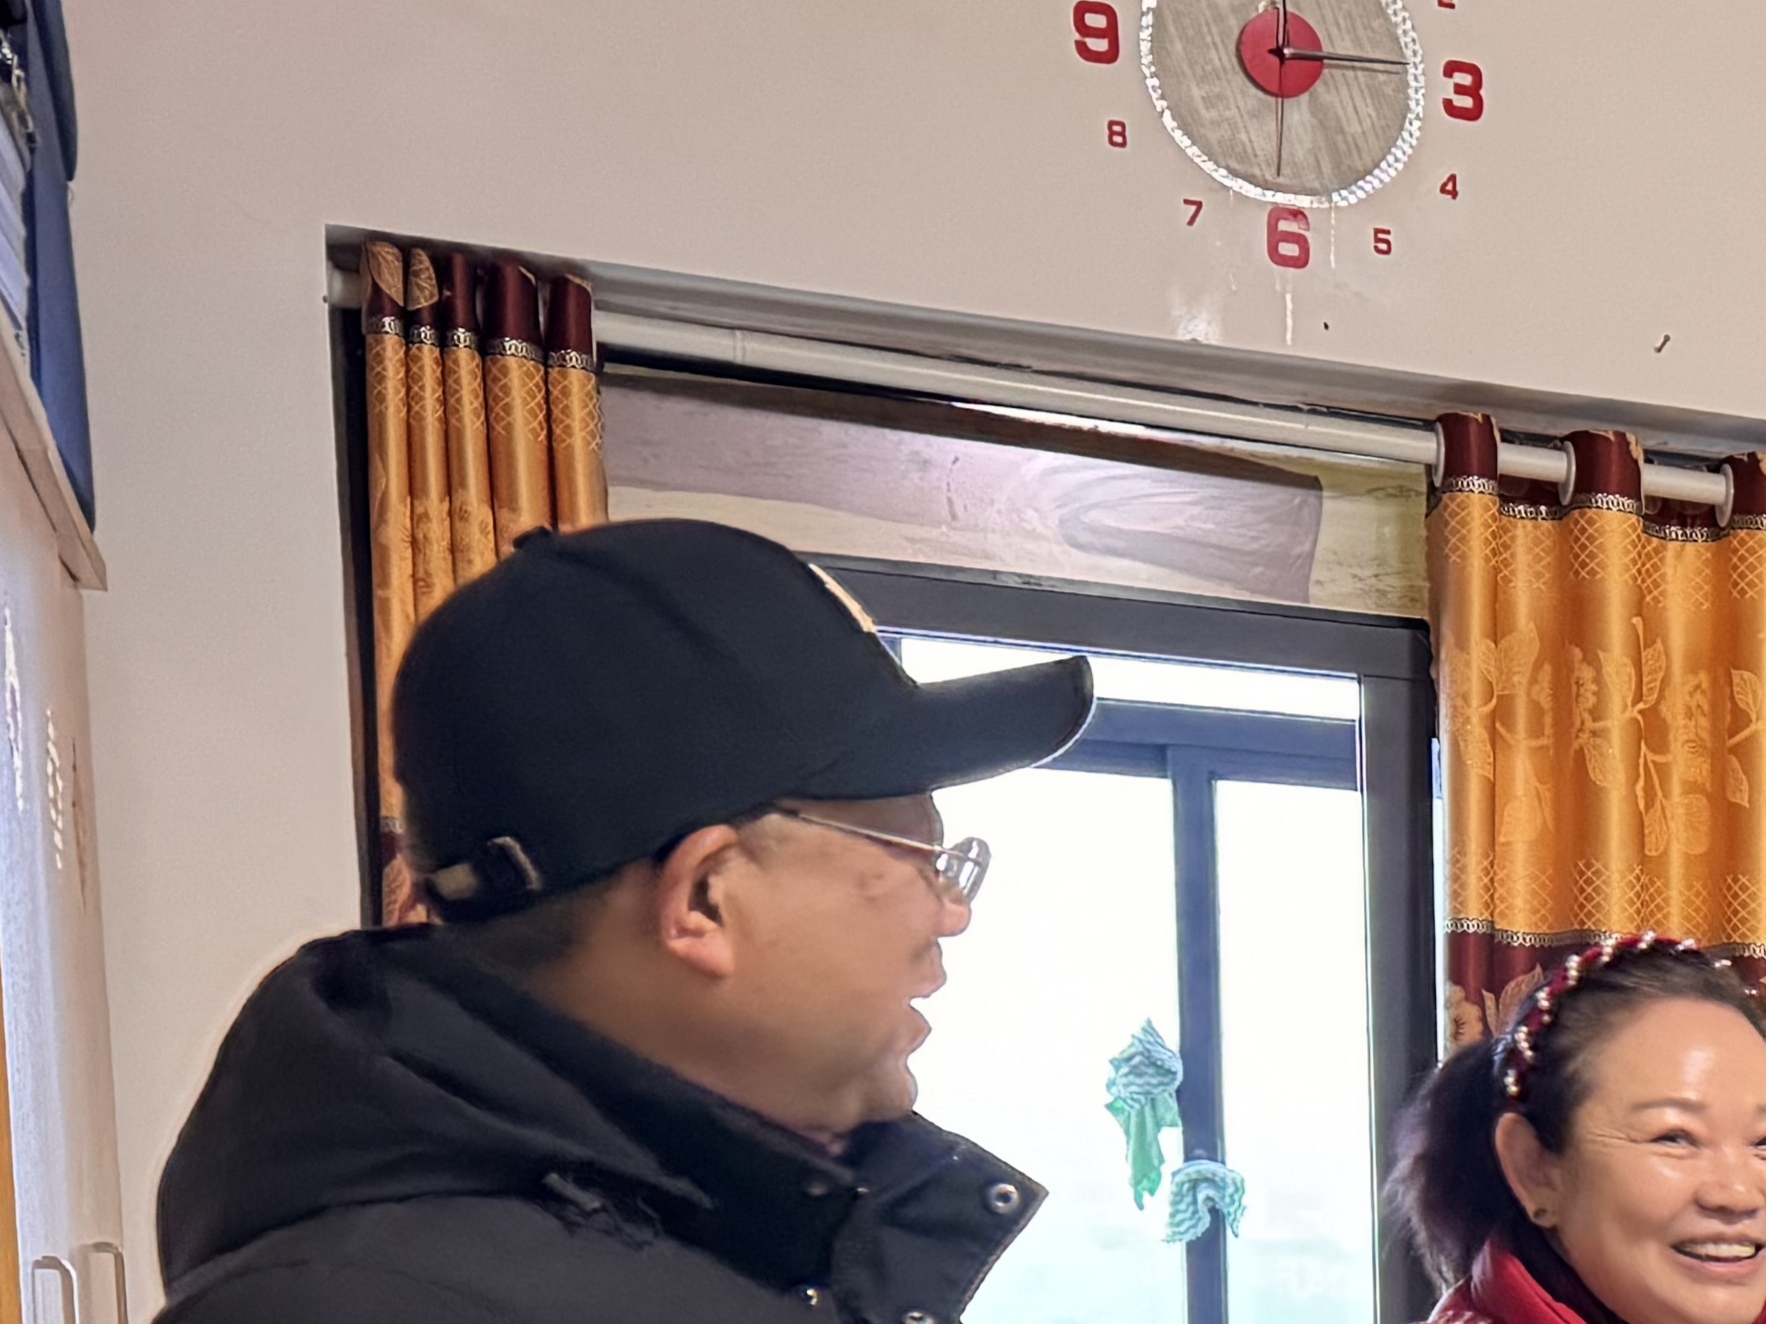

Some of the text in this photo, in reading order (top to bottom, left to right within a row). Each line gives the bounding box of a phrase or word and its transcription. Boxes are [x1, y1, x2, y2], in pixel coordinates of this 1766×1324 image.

[1072, 0, 1120, 65] 9
[1442, 60, 1484, 122] 3
[1107, 120, 1127, 148] 8
[1440, 174, 1459, 200] 4
[1183, 199, 1203, 226] 7
[1267, 206, 1310, 269] 6
[1373, 228, 1392, 255] 5
